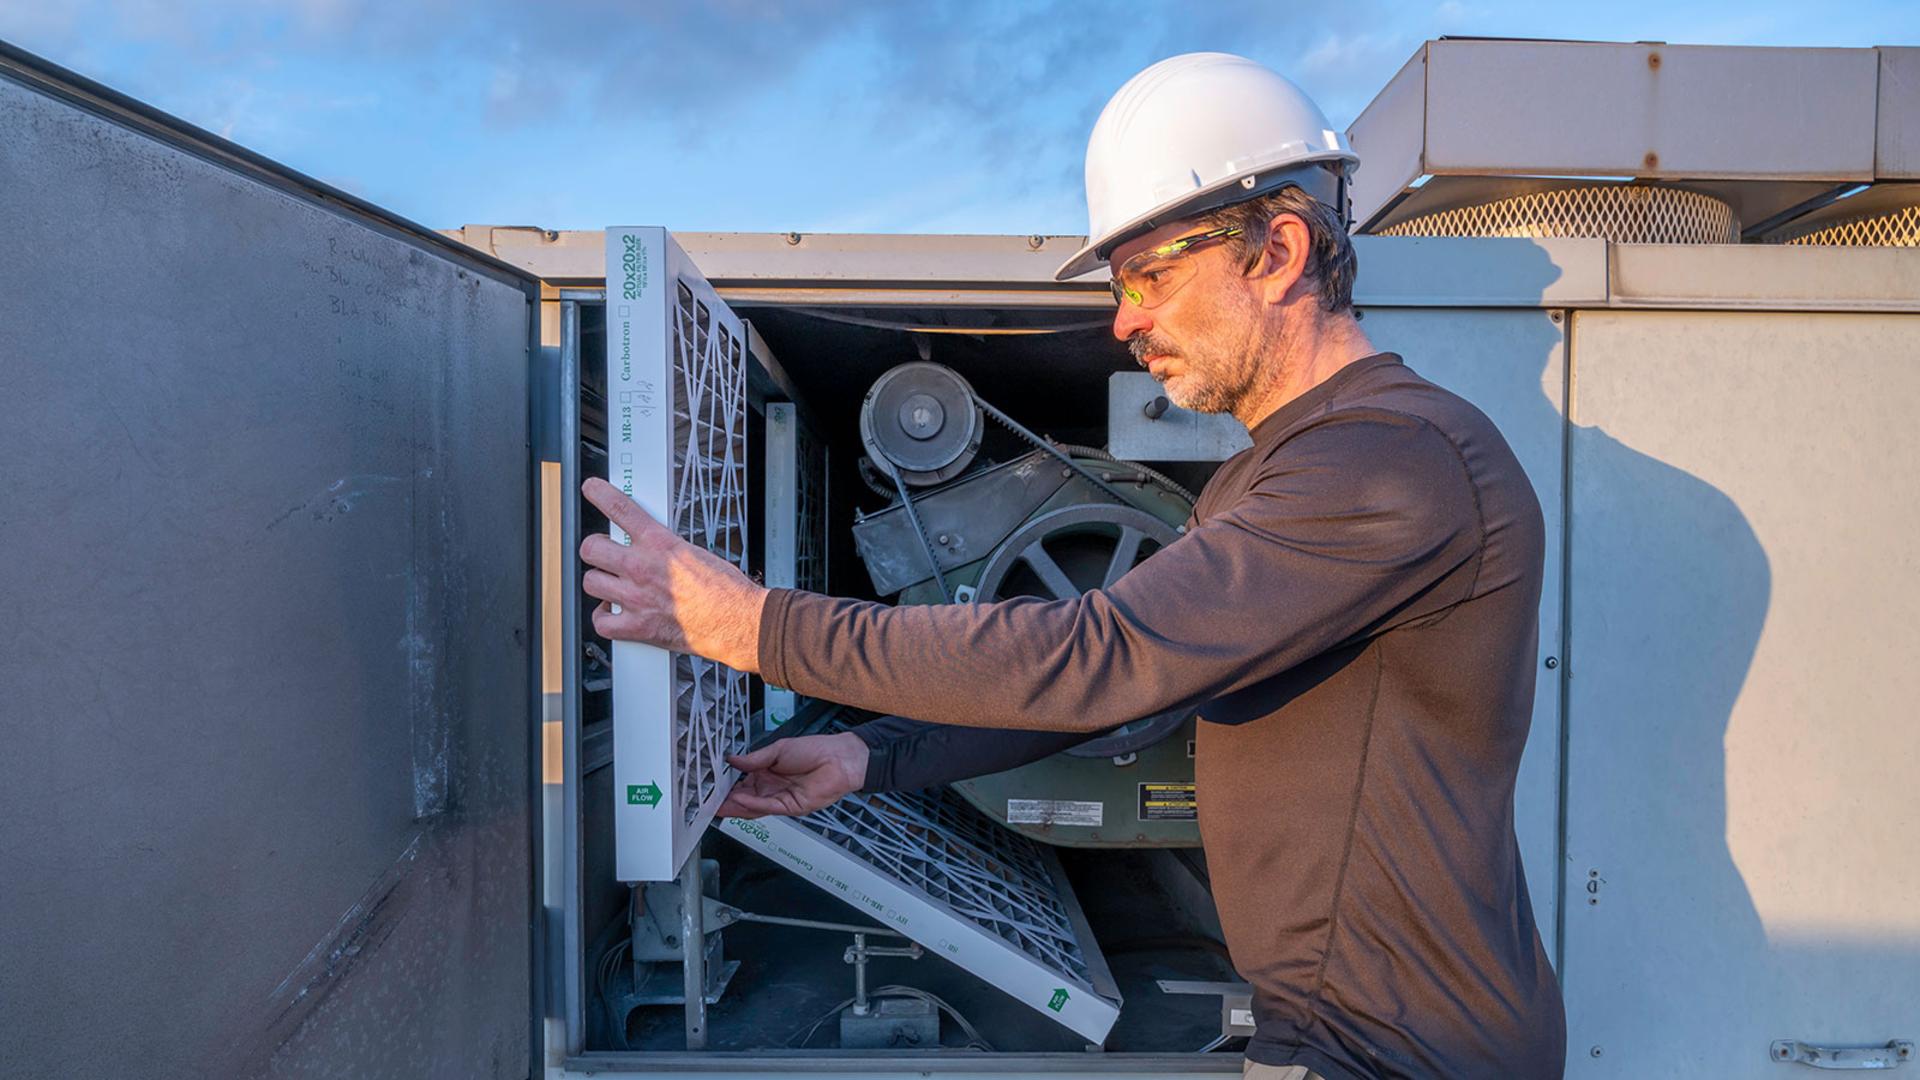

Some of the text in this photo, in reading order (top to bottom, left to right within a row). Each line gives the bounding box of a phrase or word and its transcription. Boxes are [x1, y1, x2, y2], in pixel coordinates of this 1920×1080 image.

[623, 234, 636, 300] 20x20x2
[620, 321, 632, 381] Carbotron
[622, 406, 632, 443] MR-13
